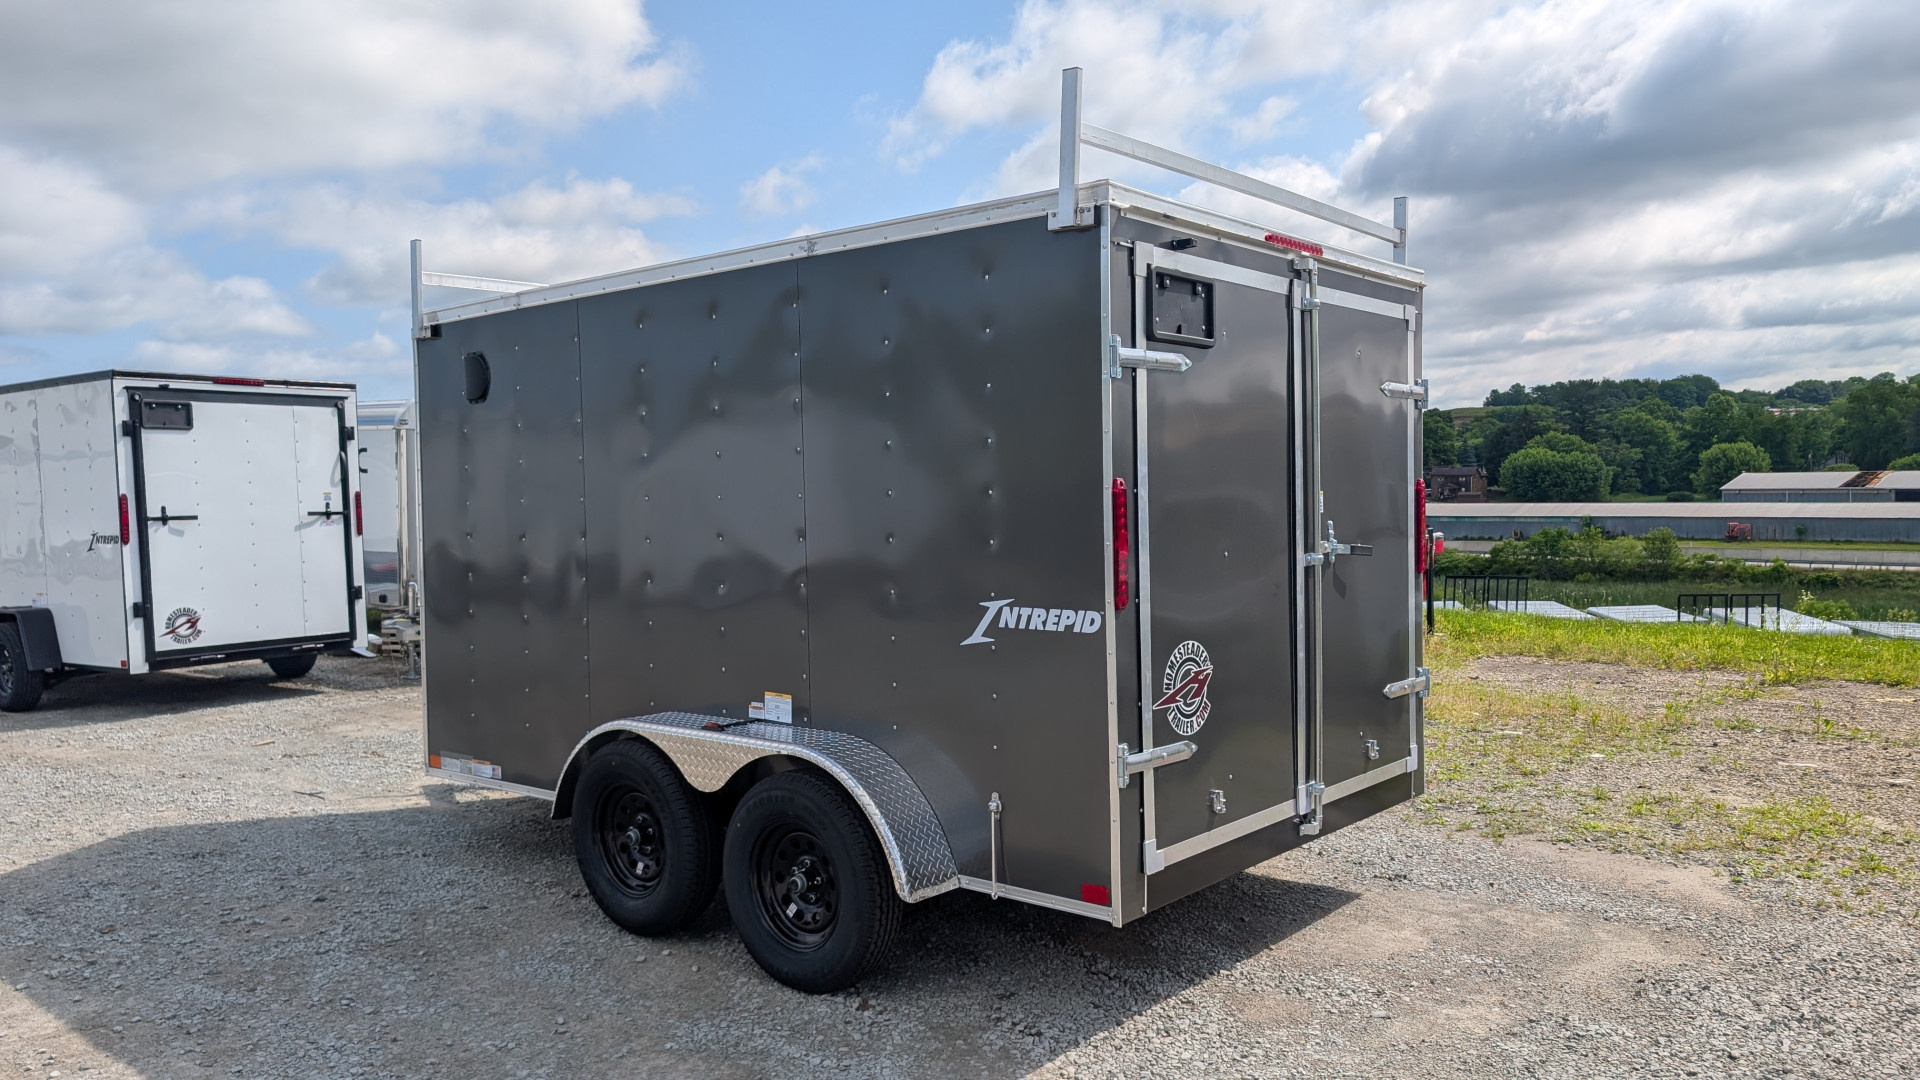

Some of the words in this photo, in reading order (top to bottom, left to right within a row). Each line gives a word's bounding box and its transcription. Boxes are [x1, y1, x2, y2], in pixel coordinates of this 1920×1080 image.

[86, 532, 120, 552] INTREPID
[165, 607, 198, 630] HOMESTEADER
[959, 598, 1102, 646] INTREPID
[1164, 641, 1209, 692] HOMESTEADER
[1167, 701, 1211, 735] TRAILER.COM
